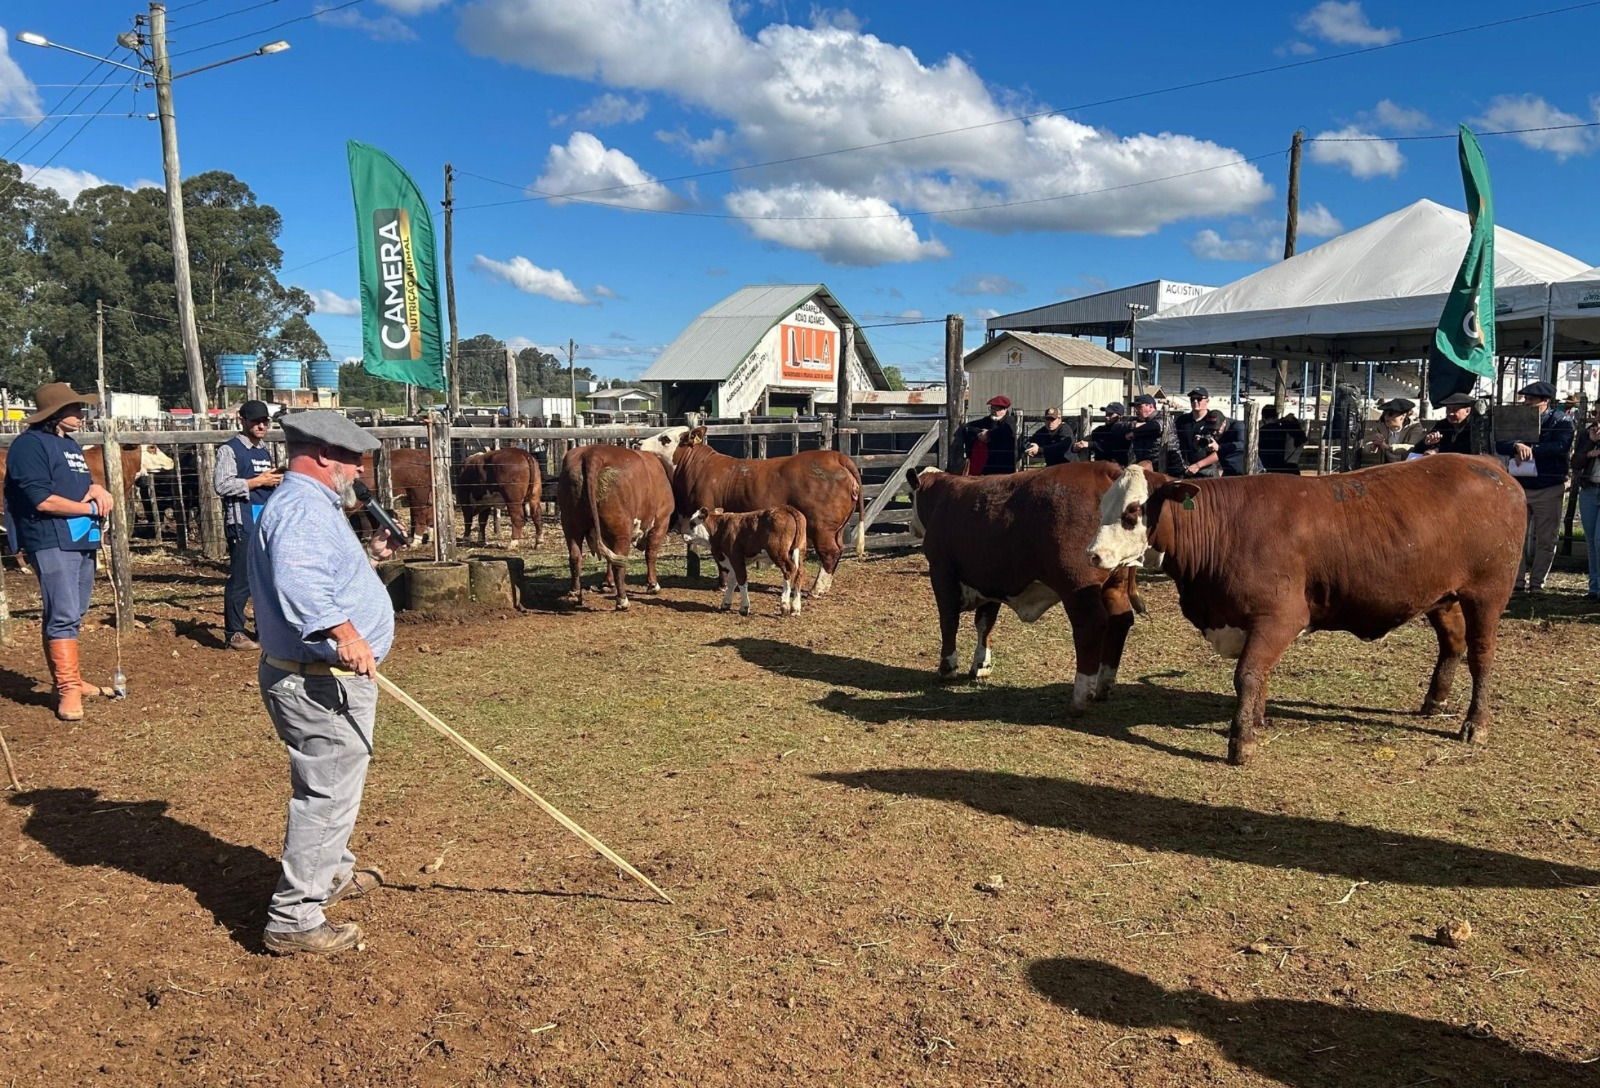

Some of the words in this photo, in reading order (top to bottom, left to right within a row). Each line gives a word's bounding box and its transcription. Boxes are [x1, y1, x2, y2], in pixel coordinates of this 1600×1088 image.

[403, 236, 416, 278] ANIMAL
[379, 219, 411, 349] CAMERA
[1166, 284, 1203, 297] AGOSTINI
[406, 278, 418, 333] NUTRIÇÃO
[798, 303, 823, 314] ASSARELA
